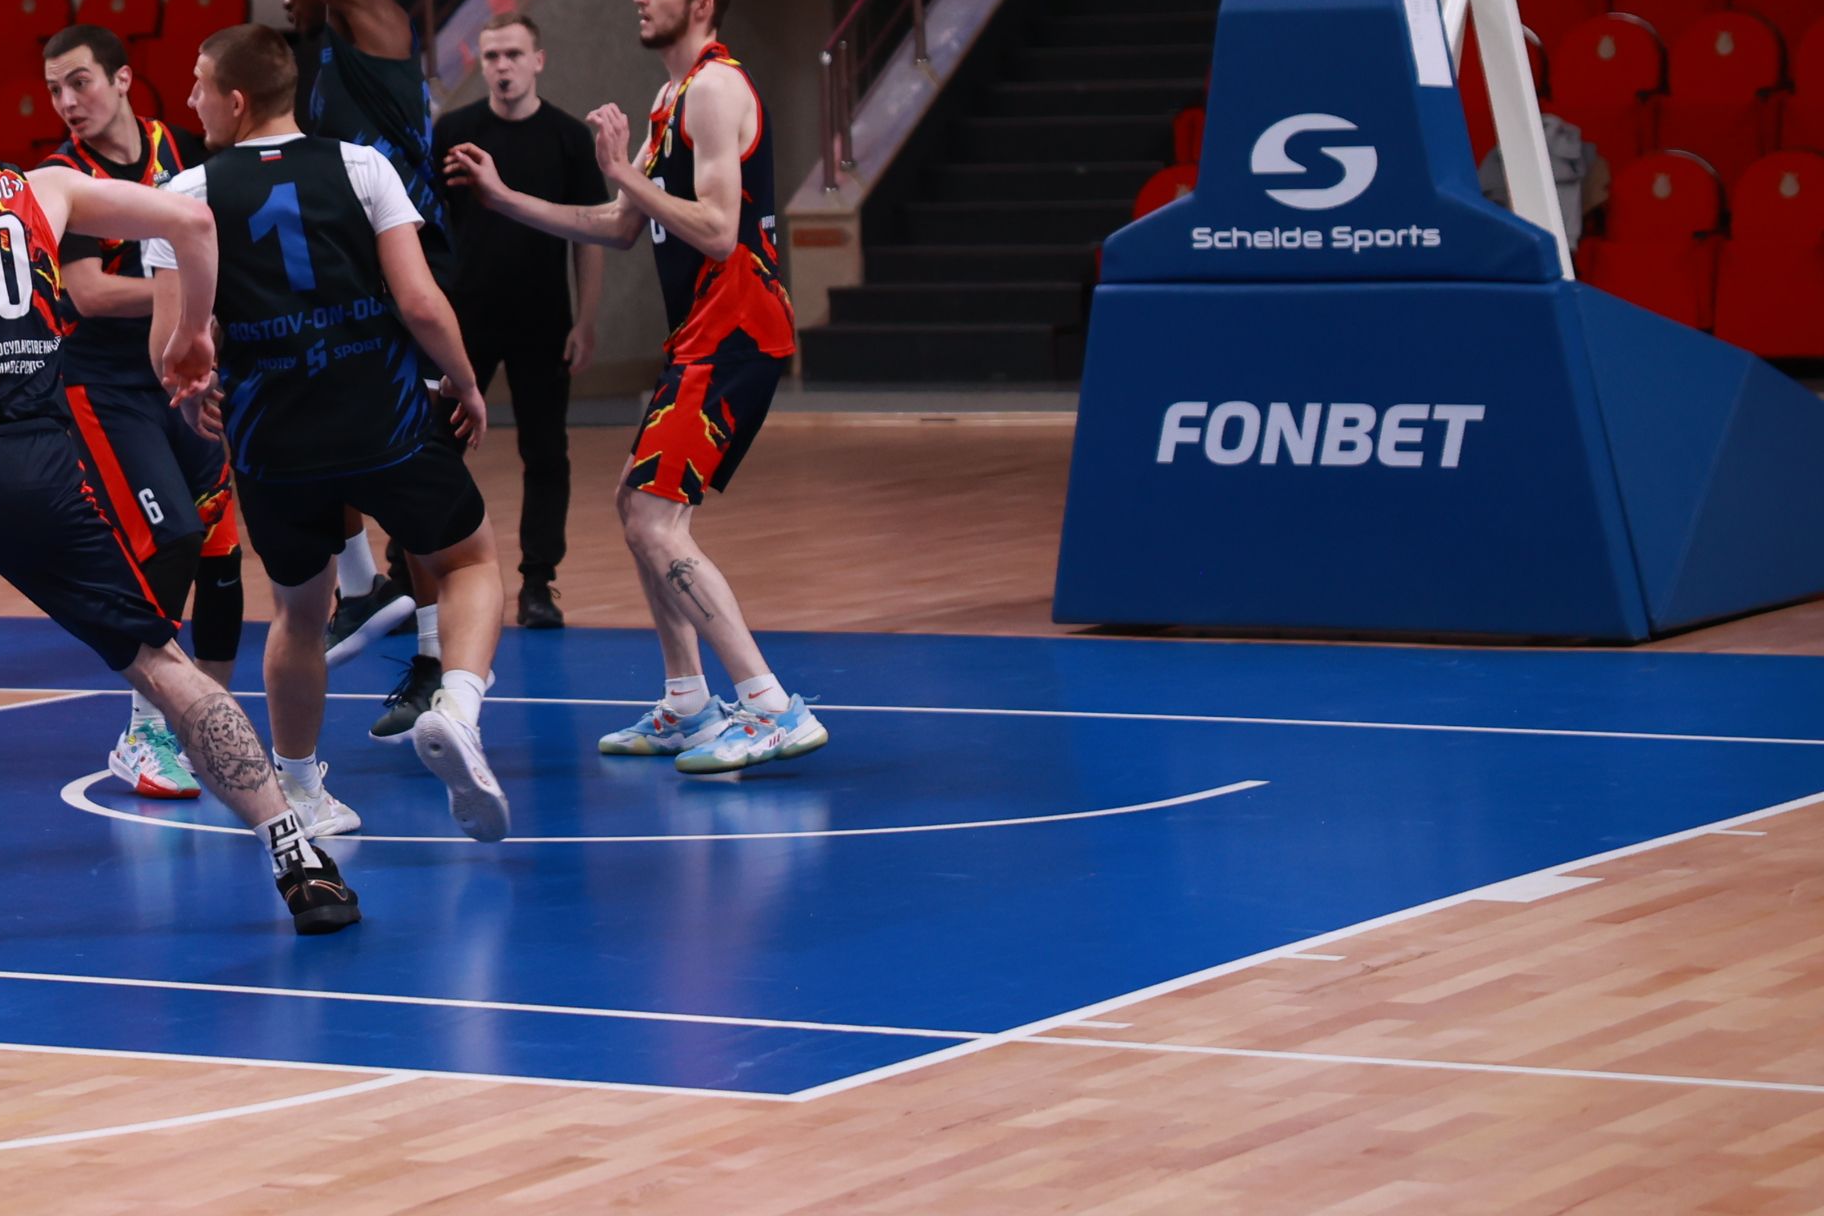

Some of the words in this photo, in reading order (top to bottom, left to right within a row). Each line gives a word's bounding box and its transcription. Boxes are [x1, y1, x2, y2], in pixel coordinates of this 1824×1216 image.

[248, 182, 316, 292] 1
[1191, 226, 1323, 250] Schelde
[1330, 224, 1441, 253] Sports
[228, 296, 388, 342] ROSTOV-ON-DO
[1156, 400, 1486, 469] FONBET
[137, 487, 165, 525] 6
